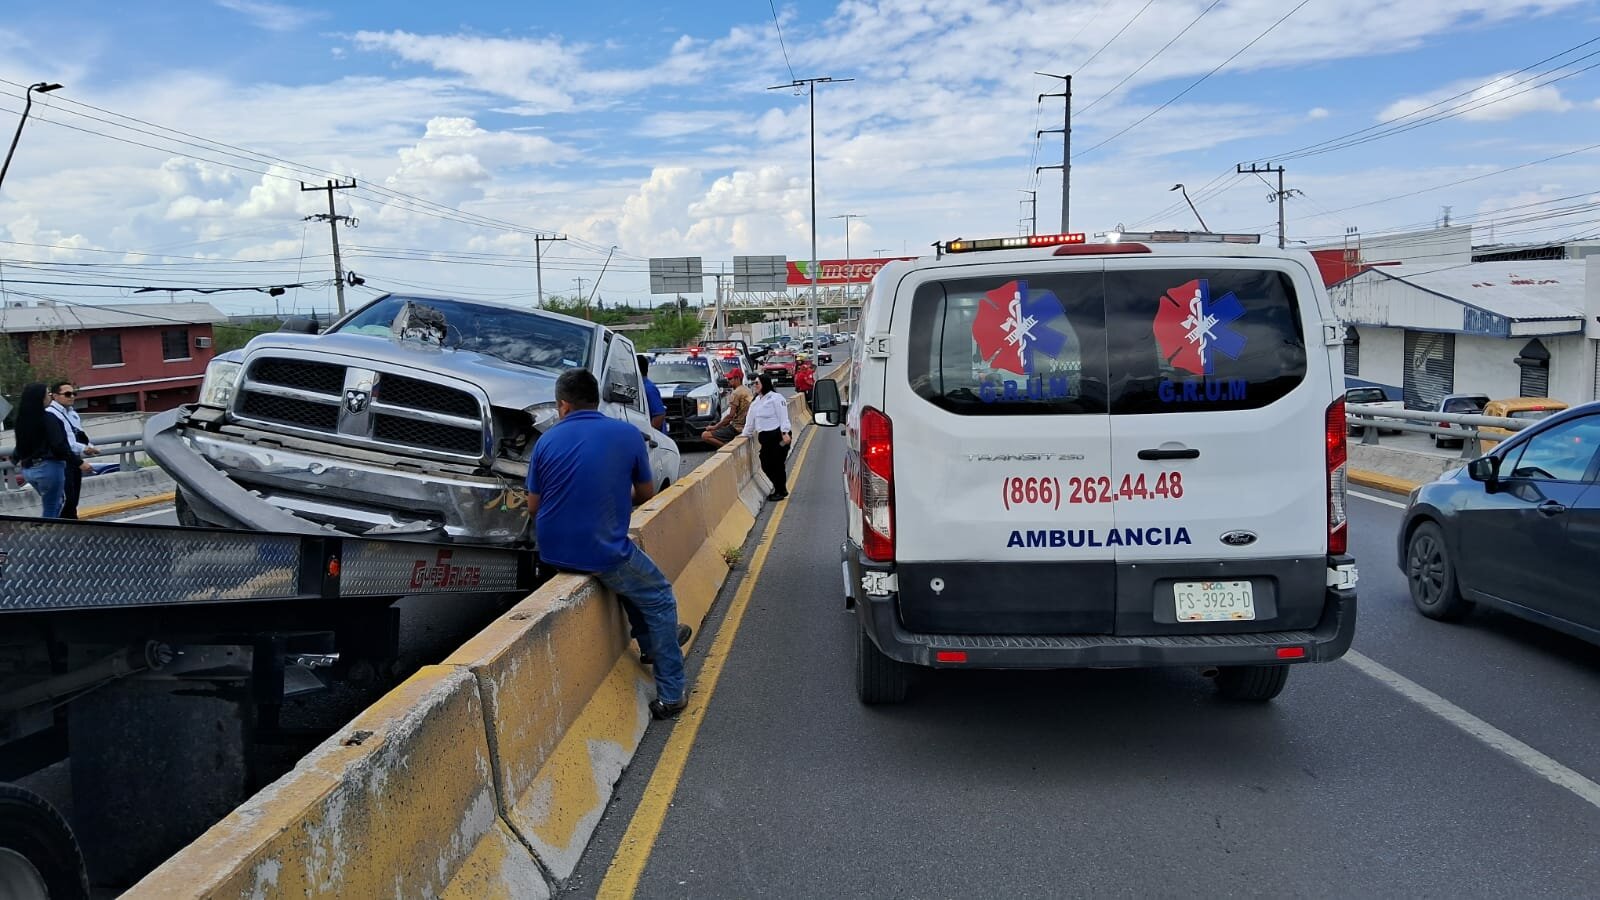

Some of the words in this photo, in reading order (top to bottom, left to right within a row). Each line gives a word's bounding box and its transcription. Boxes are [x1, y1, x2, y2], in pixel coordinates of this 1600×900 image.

[1159, 379, 1248, 402] G.R.U.M
[964, 452, 1056, 462] TRANSIT
[1058, 453, 1086, 462] 250
[1003, 476, 1062, 511] (866)
[1069, 472, 1183, 503] 262.44.48
[1007, 527, 1191, 547] AMBULANCIA
[1178, 591, 1251, 609] FS-3923-D
